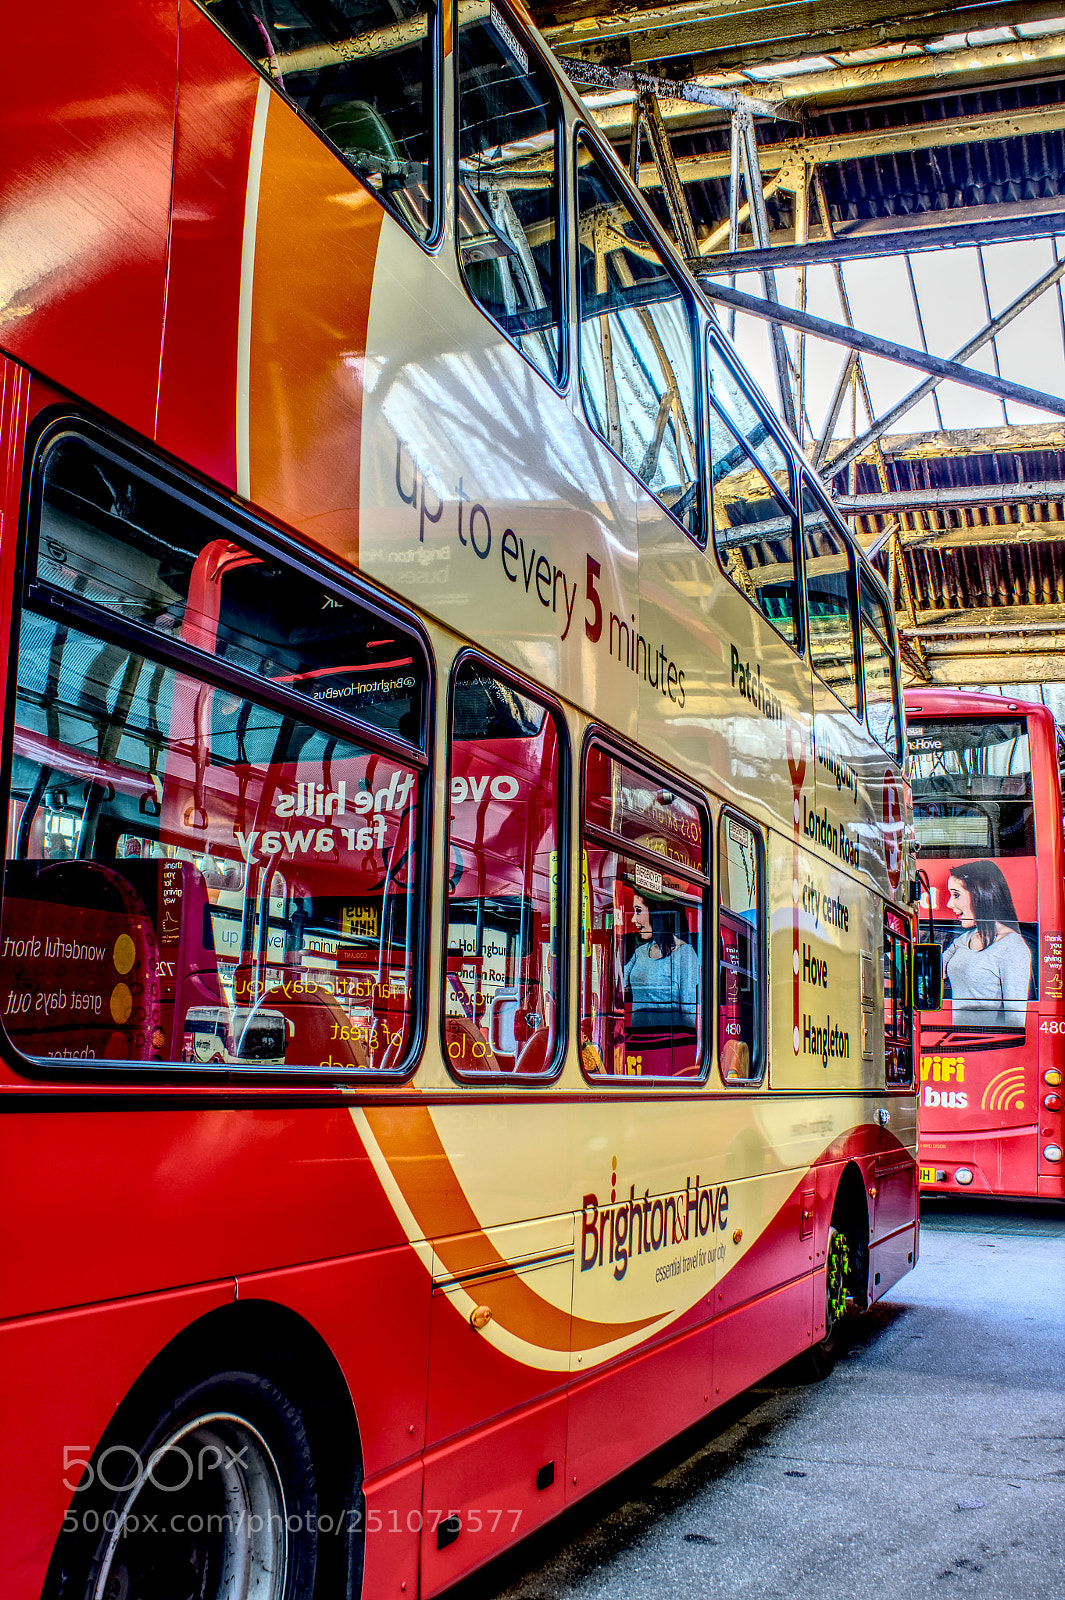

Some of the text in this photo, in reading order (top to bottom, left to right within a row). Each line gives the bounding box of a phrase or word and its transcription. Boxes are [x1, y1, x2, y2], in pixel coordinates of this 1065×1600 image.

[396, 439, 686, 709] up to every 5 minutes
[730, 643, 783, 730] Patcham
[803, 795, 838, 856] London
[839, 822, 860, 869] Road
[803, 875, 849, 933] city centre
[803, 943, 828, 989] Hove
[1043, 955, 1062, 963] giving
[803, 1014, 850, 1069] Hangleton
[924, 1086, 968, 1109] bus
[655, 1242, 727, 1283] essential travel for our city
